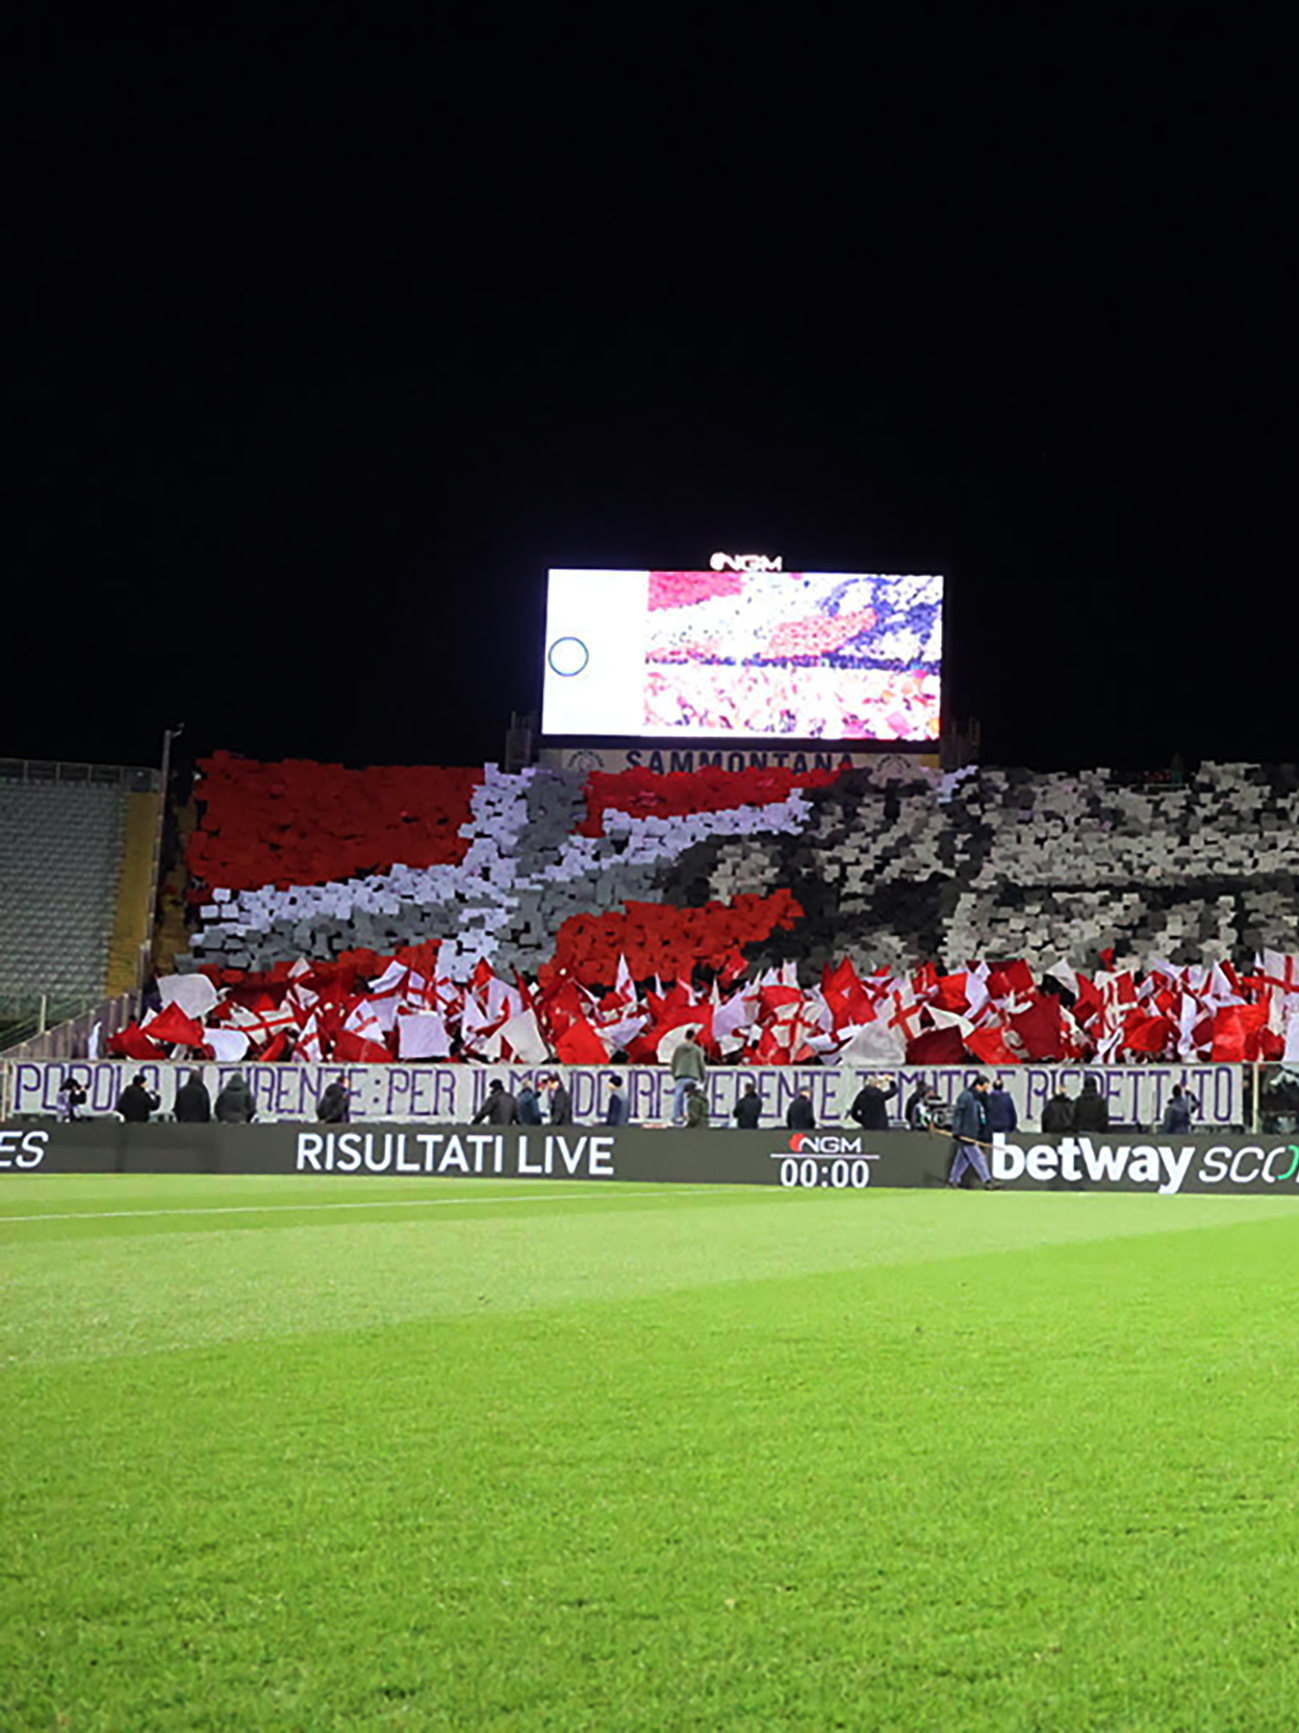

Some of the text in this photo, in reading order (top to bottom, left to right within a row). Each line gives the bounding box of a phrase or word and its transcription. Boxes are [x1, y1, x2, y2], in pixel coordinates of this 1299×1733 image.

[626, 749, 852, 775] SAMMONTANA
[296, 1133, 614, 1175] RISULTATI LIVE
[799, 1136, 862, 1153] NGM
[780, 1159, 869, 1188] 00:00
[992, 1132, 1195, 1194] betway
